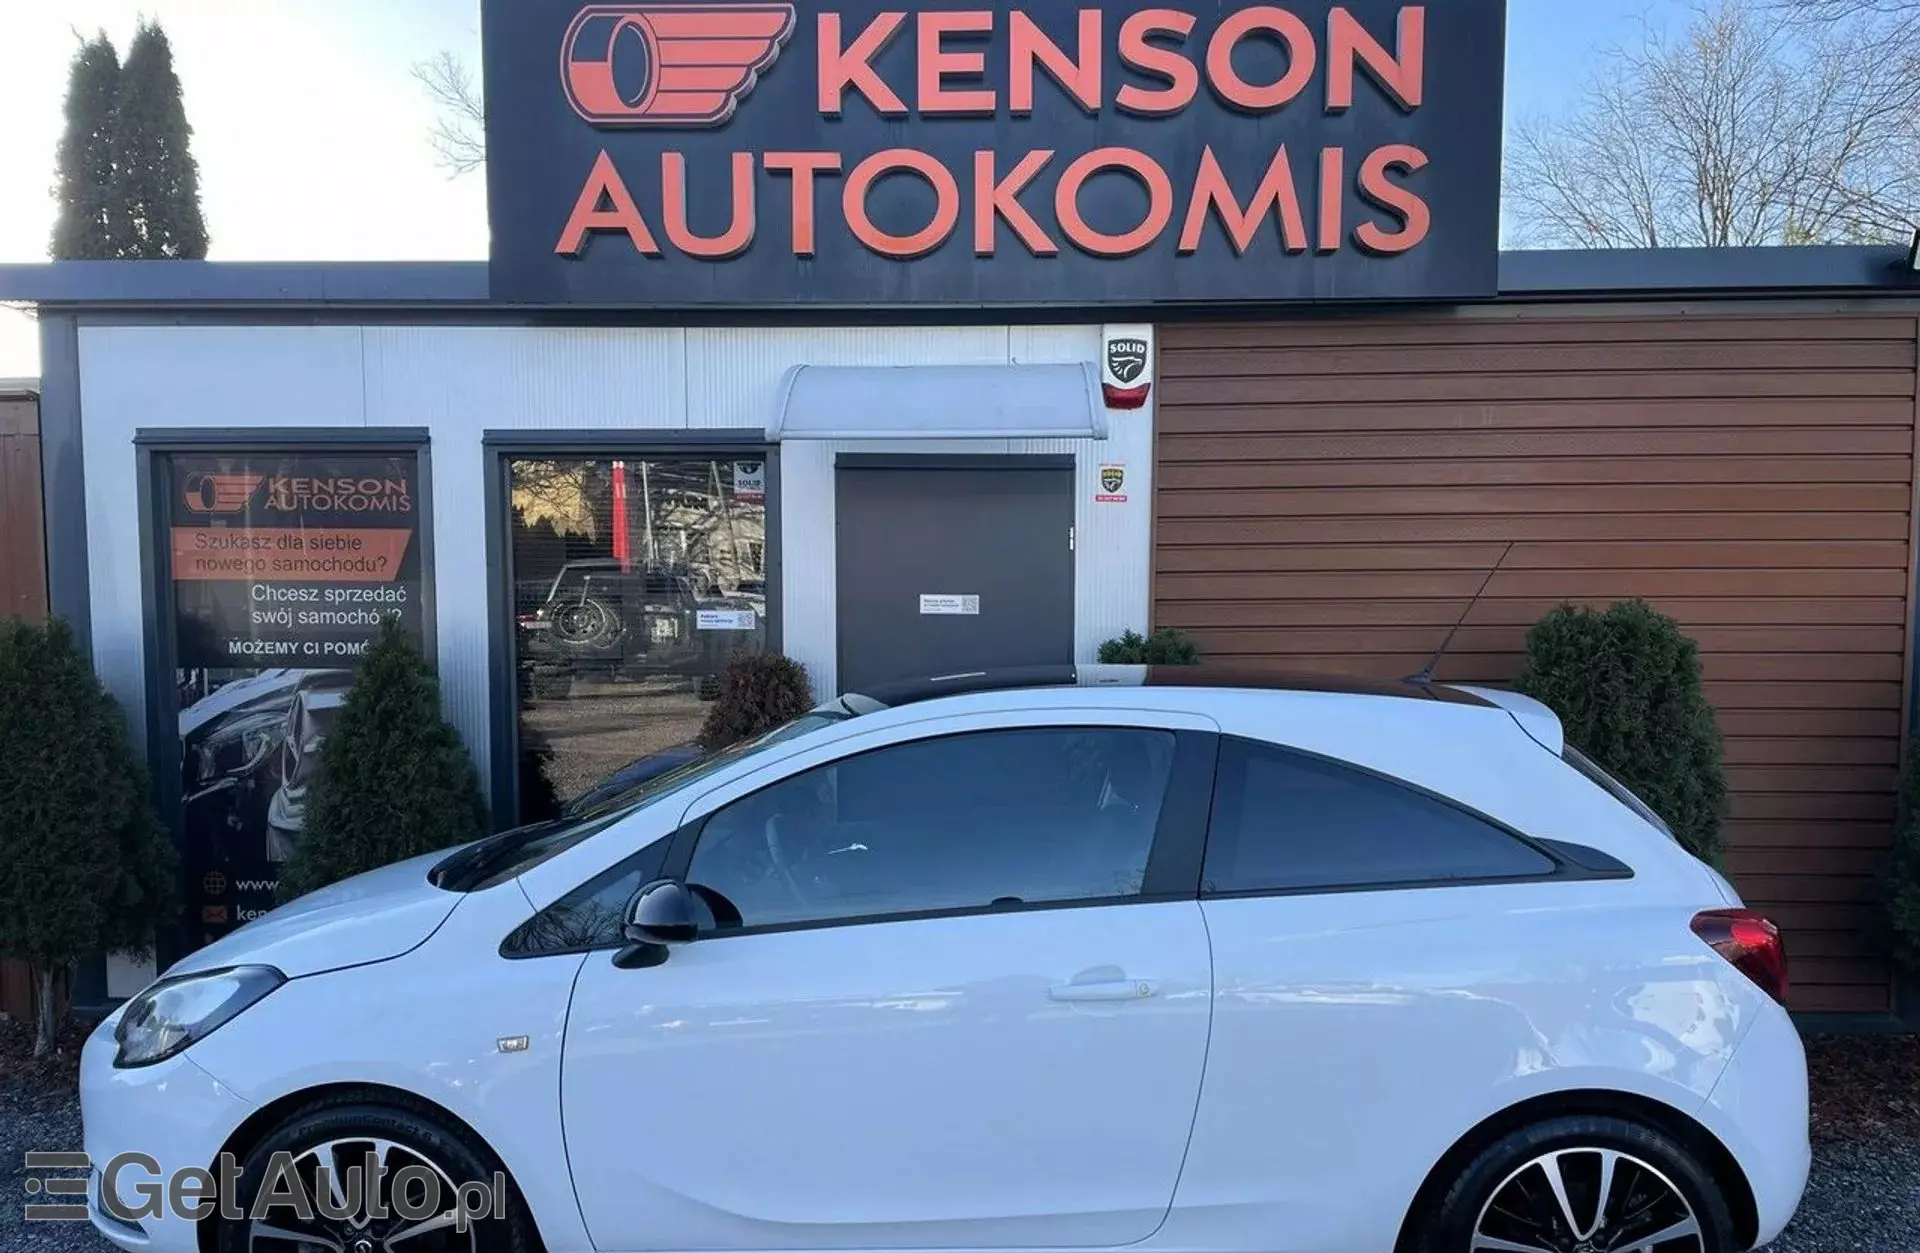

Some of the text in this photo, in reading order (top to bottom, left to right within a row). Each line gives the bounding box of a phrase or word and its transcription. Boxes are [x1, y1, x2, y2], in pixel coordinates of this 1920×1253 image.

[816, 5, 1426, 116] KENSON
[554, 143, 1431, 257] AUTOKOMIS
[1110, 342, 1145, 353] SOLID
[268, 477, 407, 495] KENSON
[264, 495, 411, 512] AUTOKOMIS
[195, 533, 362, 550] Szukasz dla siebie
[196, 556, 387, 577] nowego samochodu?
[252, 584, 407, 606] Chcesz sprzedać
[252, 608, 402, 628] swój samochó?
[229, 640, 298, 655] MOŻEMY
[304, 642, 319, 655] CI
